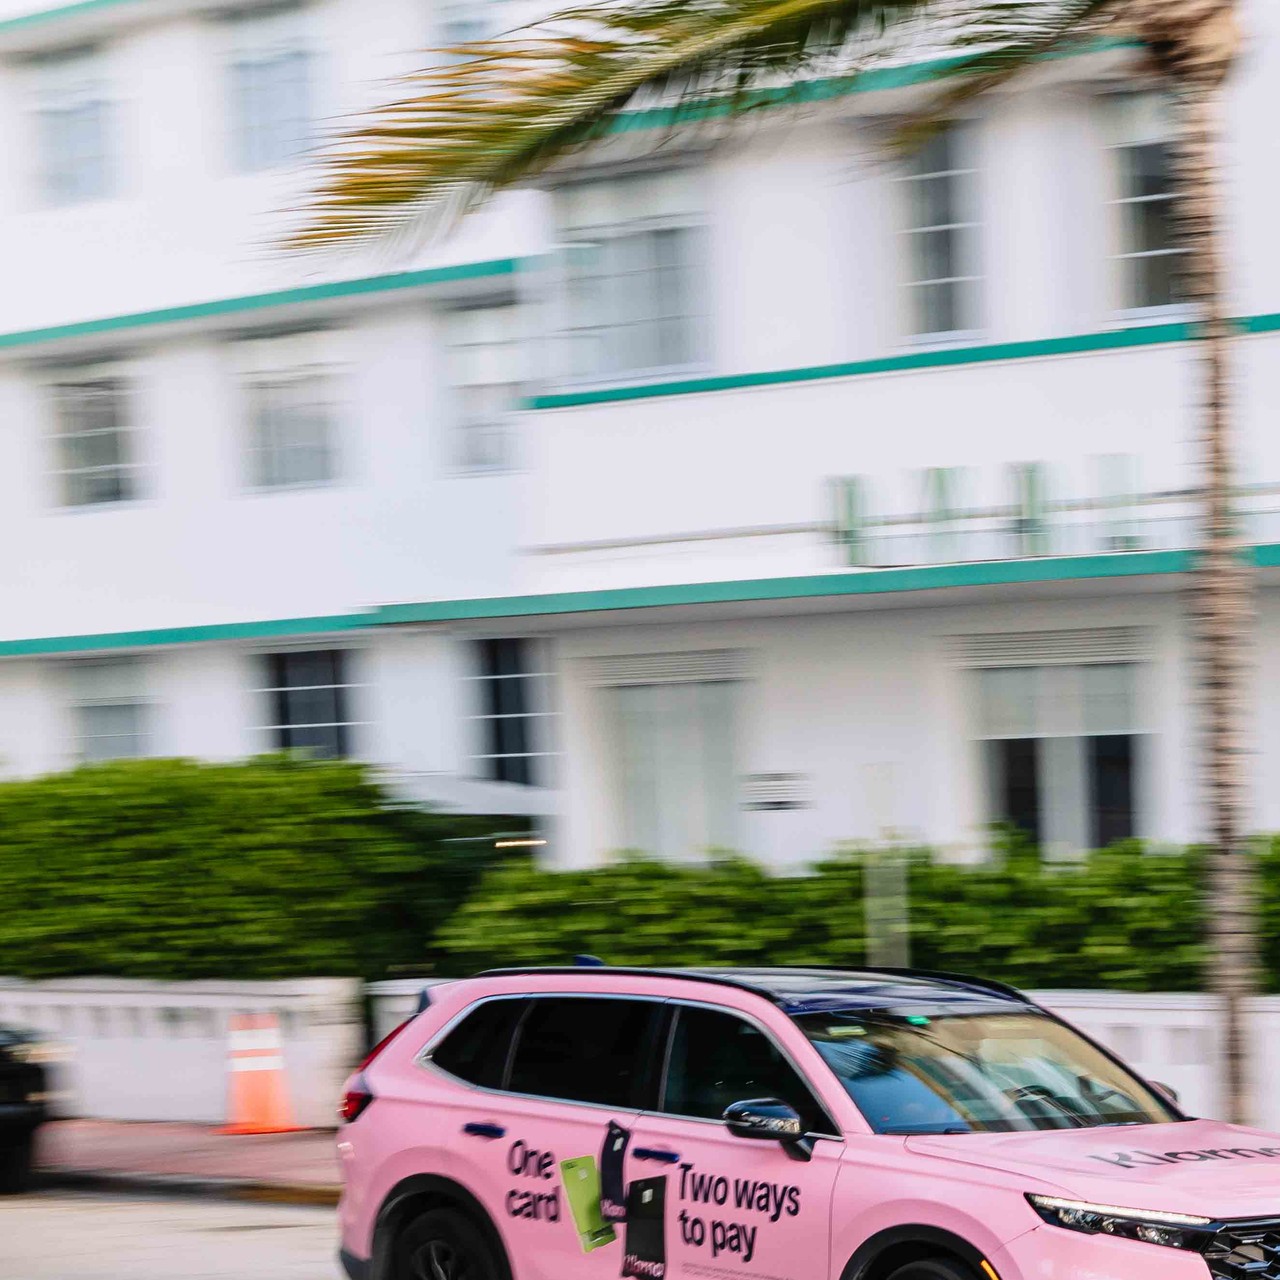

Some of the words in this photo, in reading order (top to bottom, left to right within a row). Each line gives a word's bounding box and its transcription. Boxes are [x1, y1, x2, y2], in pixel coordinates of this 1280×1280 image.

[507, 1140, 556, 1180] One
[505, 1184, 561, 1223] card
[678, 1162, 728, 1206] Two
[733, 1176, 801, 1222] ways
[678, 1208, 706, 1247] to
[711, 1219, 758, 1262] pay
